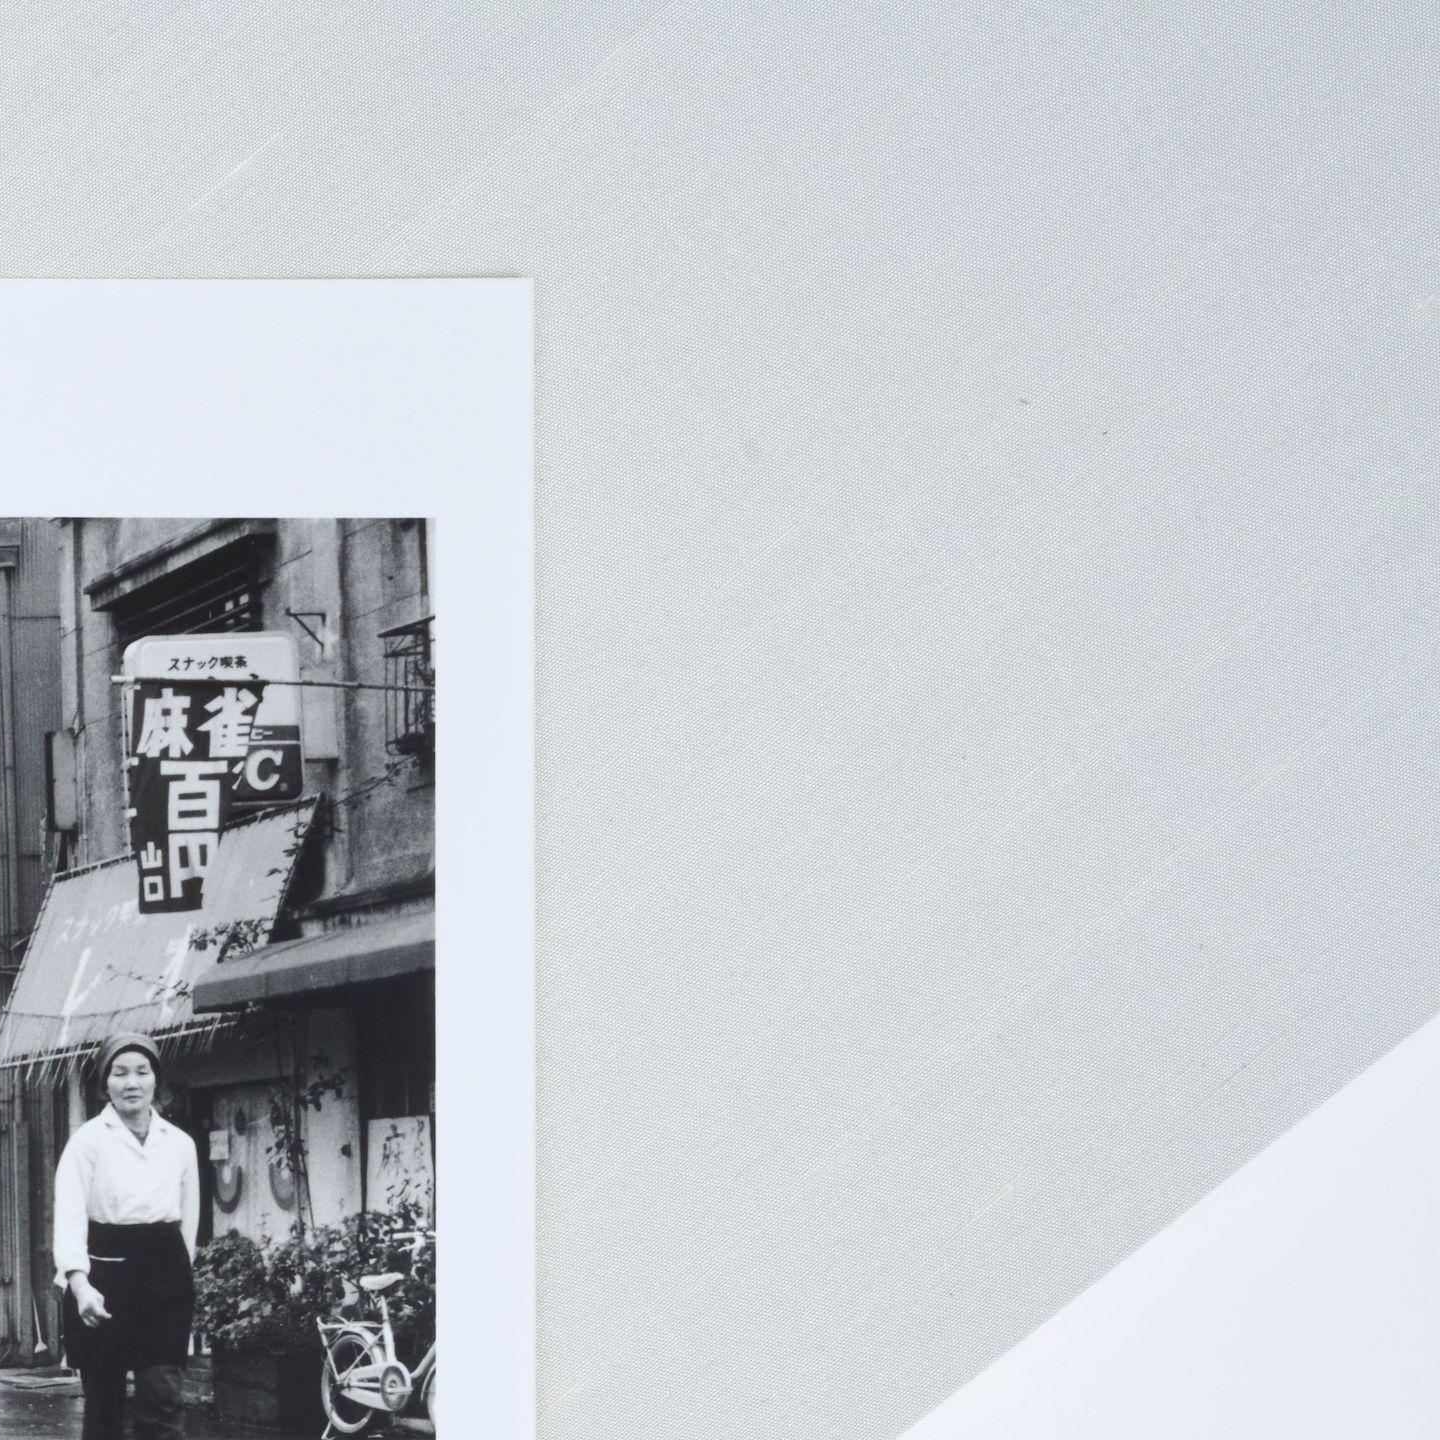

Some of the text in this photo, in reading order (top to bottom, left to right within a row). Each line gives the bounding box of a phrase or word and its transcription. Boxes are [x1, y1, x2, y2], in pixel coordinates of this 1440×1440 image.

[168, 655, 248, 672] スナック喫茶
[136, 686, 258, 758] 麻雀
[140, 841, 165, 902] 山口
